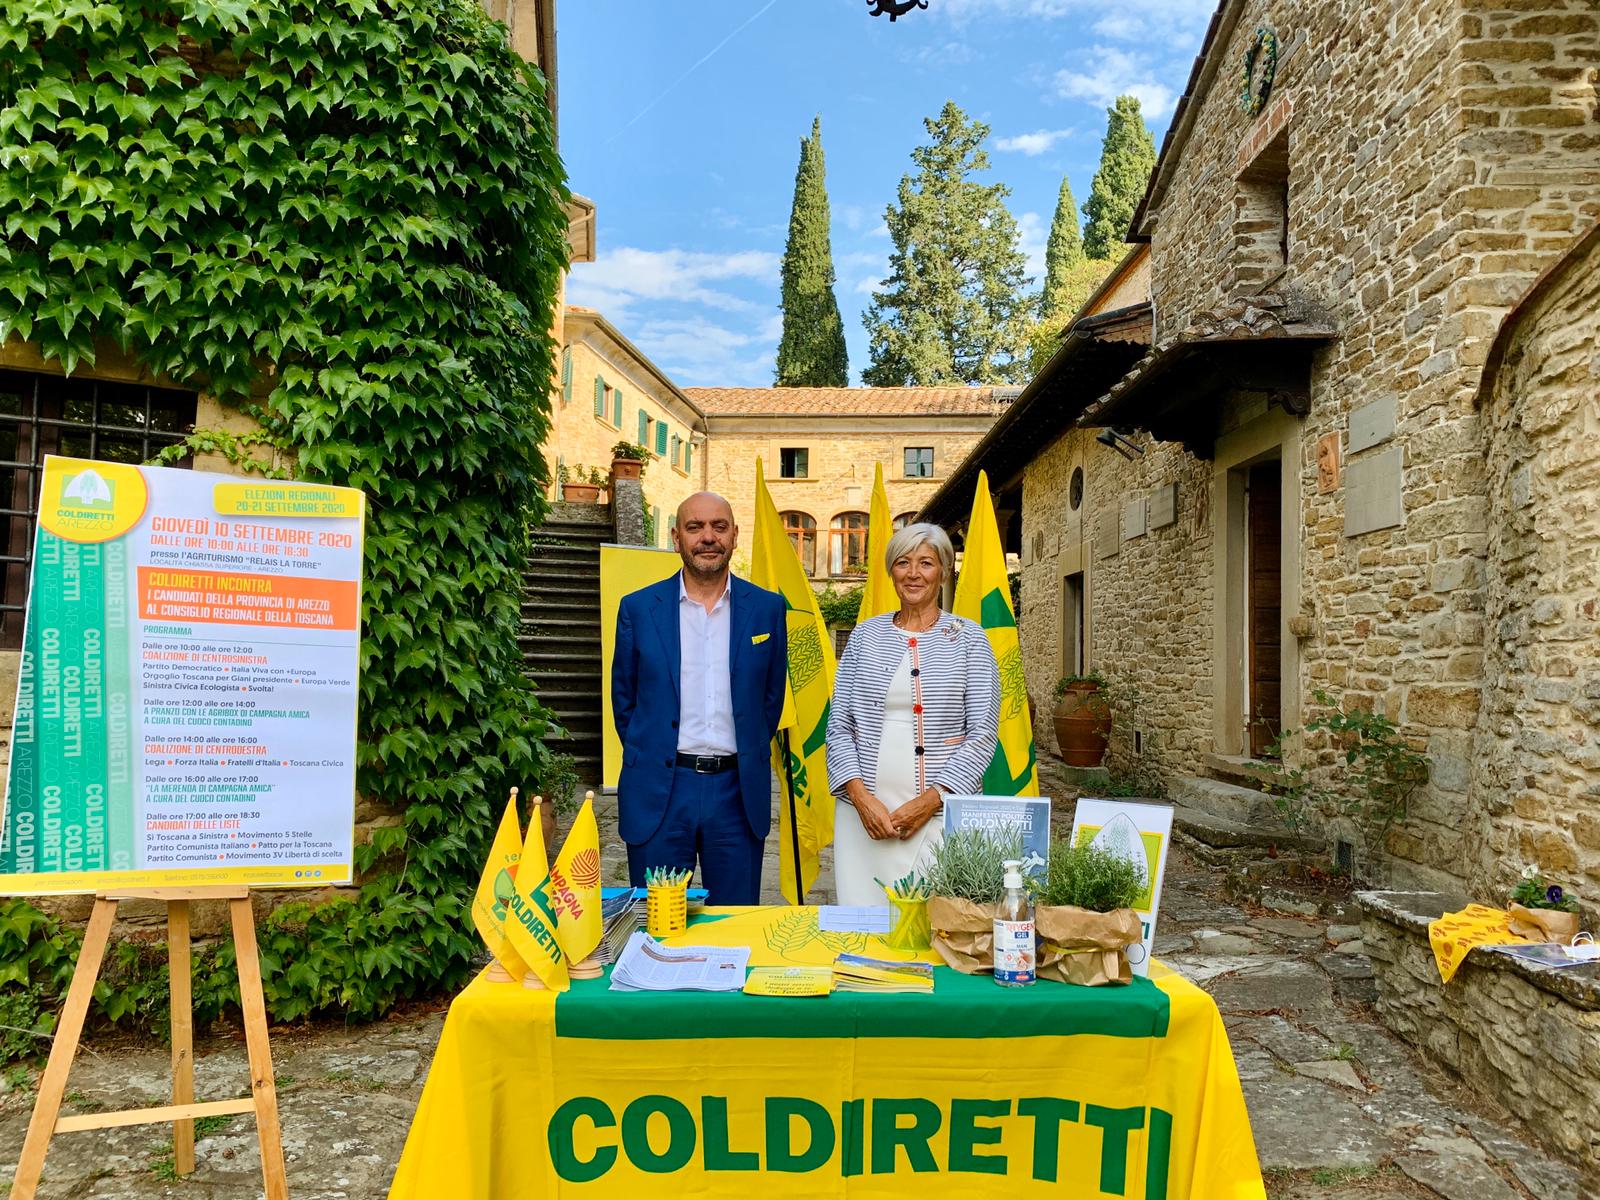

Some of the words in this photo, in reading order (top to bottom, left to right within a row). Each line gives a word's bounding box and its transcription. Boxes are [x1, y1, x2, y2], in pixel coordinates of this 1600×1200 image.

[245, 489, 285, 500] ELEZIONI
[289, 491, 335, 501] REGIONALI
[236, 501, 262, 511] 20-21
[266, 502, 319, 512] SETTEMBRE
[322, 504, 344, 513] 2020
[57, 510, 114, 520] COLDIRETTI
[57, 519, 113, 530] AREZZO
[152, 516, 209, 535] GIOVEDÌ
[215, 521, 229, 537] 10
[234, 523, 313, 545] SETTEMBRE
[318, 532, 352, 548] 2020
[151, 535, 181, 546] DALLE
[184, 537, 204, 548] ORE
[208, 539, 233, 550] 10:00
[237, 542, 259, 552] ALLE
[263, 544, 280, 555] ORE
[285, 546, 308, 557] 18:30
[151, 550, 178, 558] presso
[149, 572, 213, 590] COLDIRETTI
[217, 576, 272, 593] INCONTRA
[147, 589, 151, 600] I
[154, 590, 203, 603] CANDIDATI
[206, 592, 233, 605] DELLA
[236, 595, 283, 608] PROVINCIA
[286, 598, 295, 608] DI
[297, 599, 330, 611] AREZZO
[146, 604, 158, 615] AL
[161, 604, 210, 618] CONSIGLIO
[213, 608, 262, 621] REGIONALE
[265, 611, 291, 623] DELLA
[295, 613, 334, 625] TOSCANA
[144, 625, 192, 635] PROGRAMMA
[143, 642, 162, 650] Dalle
[143, 651, 188, 661] COALIZIONE
[192, 653, 200, 662] DI
[202, 654, 267, 664] CENTROSINISTRA
[42, 628, 60, 718] COLDIRETTI
[84, 628, 101, 718] COLDIRETTI
[172, 664, 222, 672] Democratico
[143, 672, 180, 680] Orgoglio
[201, 684, 239, 692] Ecologista
[64, 666, 81, 757] COLDIRETTI
[151, 707, 180, 715] PRANZO
[182, 708, 196, 716] CON
[208, 709, 238, 717] AGRIBOX
[241, 709, 247, 717] DI
[249, 710, 287, 718] CAMPAGNA
[152, 717, 170, 725] CURA
[188, 718, 211, 726] CUOCO
[145, 744, 192, 754] COALIZIONE
[195, 745, 203, 754] DI
[206, 746, 267, 755] CENTRODESTRA
[162, 785, 197, 793] MERENDA
[199, 785, 206, 793] DI
[154, 795, 173, 803] CURA
[190, 794, 214, 802] CUOCO
[216, 794, 255, 802] CONTADINO
[147, 821, 191, 830] CANDIDATI
[193, 820, 217, 829] DELLE
[220, 820, 240, 828] LISTE
[176, 843, 218, 851] Comunista
[176, 853, 217, 861] Comunista
[547, 1095, 1173, 1200] COLDIRETTI
